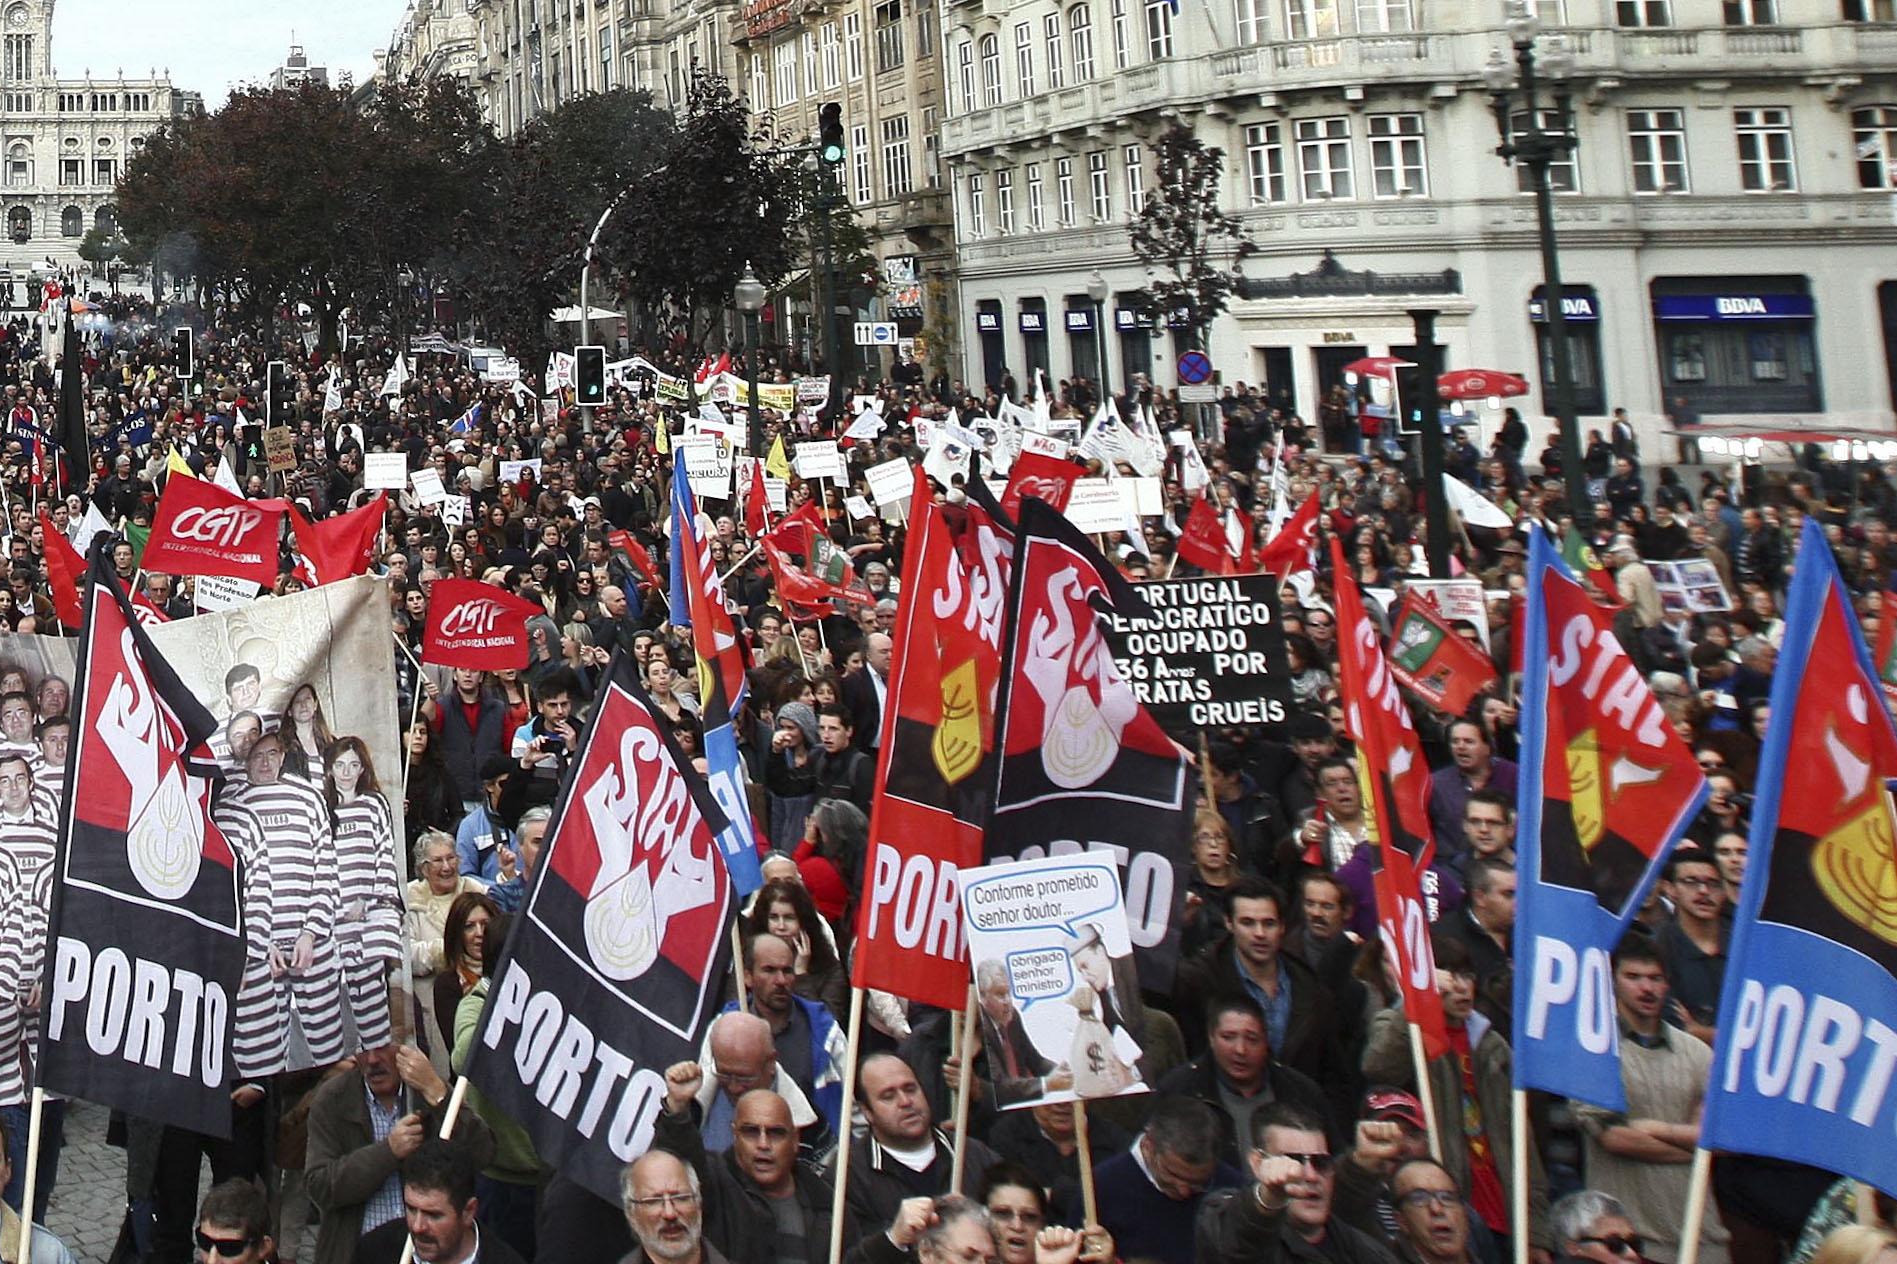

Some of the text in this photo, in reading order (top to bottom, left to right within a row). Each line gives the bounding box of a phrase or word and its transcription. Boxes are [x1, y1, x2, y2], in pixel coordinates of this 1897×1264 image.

[1716, 297, 1767, 315] BBVA
[1322, 331, 1354, 343] BBVA
[171, 504, 262, 547] CGTP
[440, 598, 511, 637] CGTP
[1127, 629, 1246, 656] OCUPADO
[1114, 658, 1148, 679] 36
[1213, 652, 1268, 676] POR
[974, 871, 1099, 905] Conforme prometido
[978, 905, 1021, 928] senhor
[1011, 951, 1064, 972] obrigado
[1013, 965, 1055, 982] senhor
[1015, 977, 1063, 994] ministro
[48, 937, 228, 1089] PORTO
[484, 957, 668, 1164] PORTO
[1724, 979, 1897, 1129] PORT
